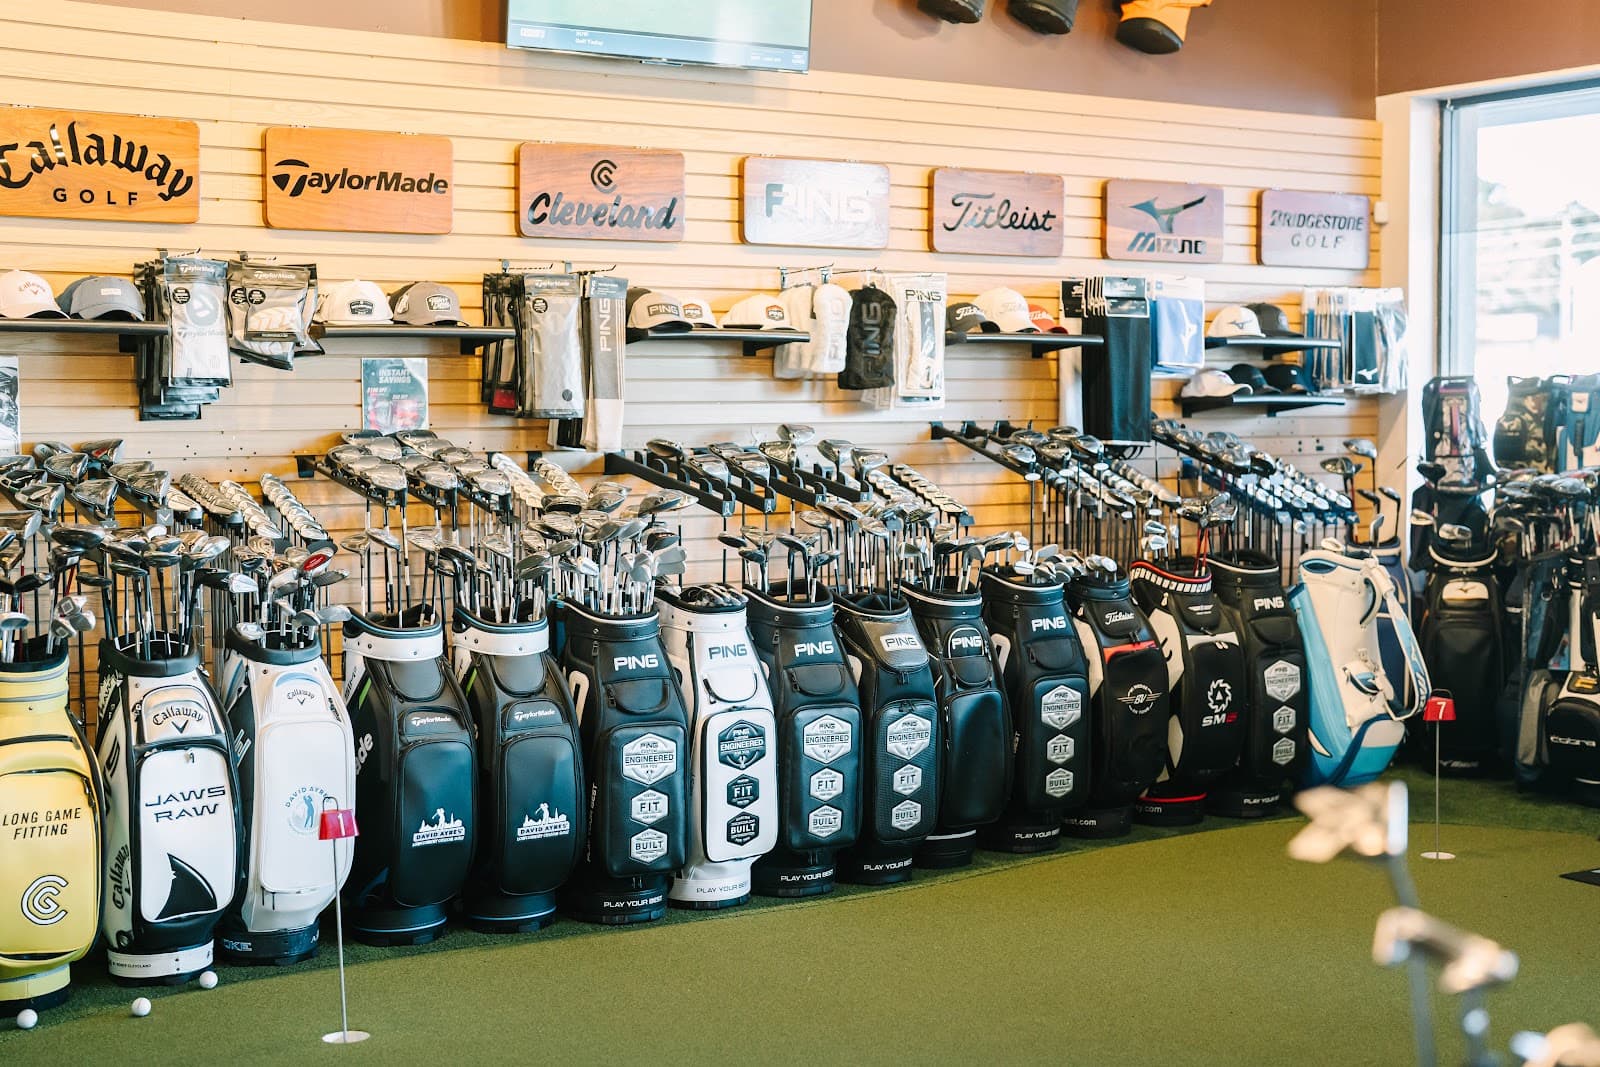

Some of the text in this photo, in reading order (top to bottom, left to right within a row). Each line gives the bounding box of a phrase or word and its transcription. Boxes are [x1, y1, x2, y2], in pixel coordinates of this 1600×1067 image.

[0, 120, 194, 202] Callaway
[272, 158, 448, 197] TaylorMade
[53, 187, 138, 206] GOLF
[765, 183, 874, 225] PING
[528, 192, 679, 230] Cleveland
[943, 192, 1057, 232] Titleist
[1270, 208, 1364, 232] BRIDGESTONE
[1291, 231, 1345, 249] GOLF
[253, 270, 296, 280] TaylorMade
[905, 289, 942, 302] PING
[649, 305, 680, 316] PING
[600, 297, 612, 352] PING
[862, 301, 882, 381] PING
[1253, 596, 1285, 611] PING
[1031, 616, 1067, 632] PING
[1104, 611, 1135, 625] Titleist
[885, 636, 919, 648] PING
[952, 635, 982, 650] PING
[708, 644, 748, 660] PING
[794, 641, 834, 657] PING
[614, 654, 659, 671] PING
[286, 689, 315, 701] Callaway
[1043, 703, 1080, 712] ENGINEERED
[1436, 701, 1447, 720] 7
[152, 705, 204, 726] Callaway
[411, 716, 452, 727] TaylorMade
[514, 709, 556, 722] TaylorMade
[1278, 715, 1291, 724] FIT
[733, 728, 750, 736] PING
[888, 731, 930, 742] ENGINEERED
[640, 741, 658, 749] PING
[720, 739, 764, 751] ENGINEERED
[805, 734, 849, 744] ENGINEERED
[1550, 735, 1597, 747] cobra
[1053, 744, 1069, 754] FIT
[625, 753, 674, 764] ENGINEERED
[818, 779, 836, 790] FIT
[900, 774, 916, 785] FIT
[1049, 778, 1071, 787] BUILT
[145, 785, 226, 807] JAWS
[285, 787, 307, 808] DAVID
[734, 786, 753, 798] FIT
[154, 803, 219, 823] RAW
[640, 801, 660, 813] FIT
[2, 807, 82, 827] LONG GAME
[895, 810, 918, 820] BUILT
[813, 817, 838, 826] BUILT
[13, 823, 69, 841] FITTING
[416, 829, 463, 841] DAVID AYRES
[520, 827, 543, 835] DAVID
[730, 823, 756, 835] BUILT
[635, 841, 663, 851] BUILT
[109, 843, 131, 910] Callaway
[802, 872, 822, 880] YOUR
[822, 868, 834, 878] BEST
[627, 899, 649, 907] YOUR
[649, 895, 663, 904] BEST
